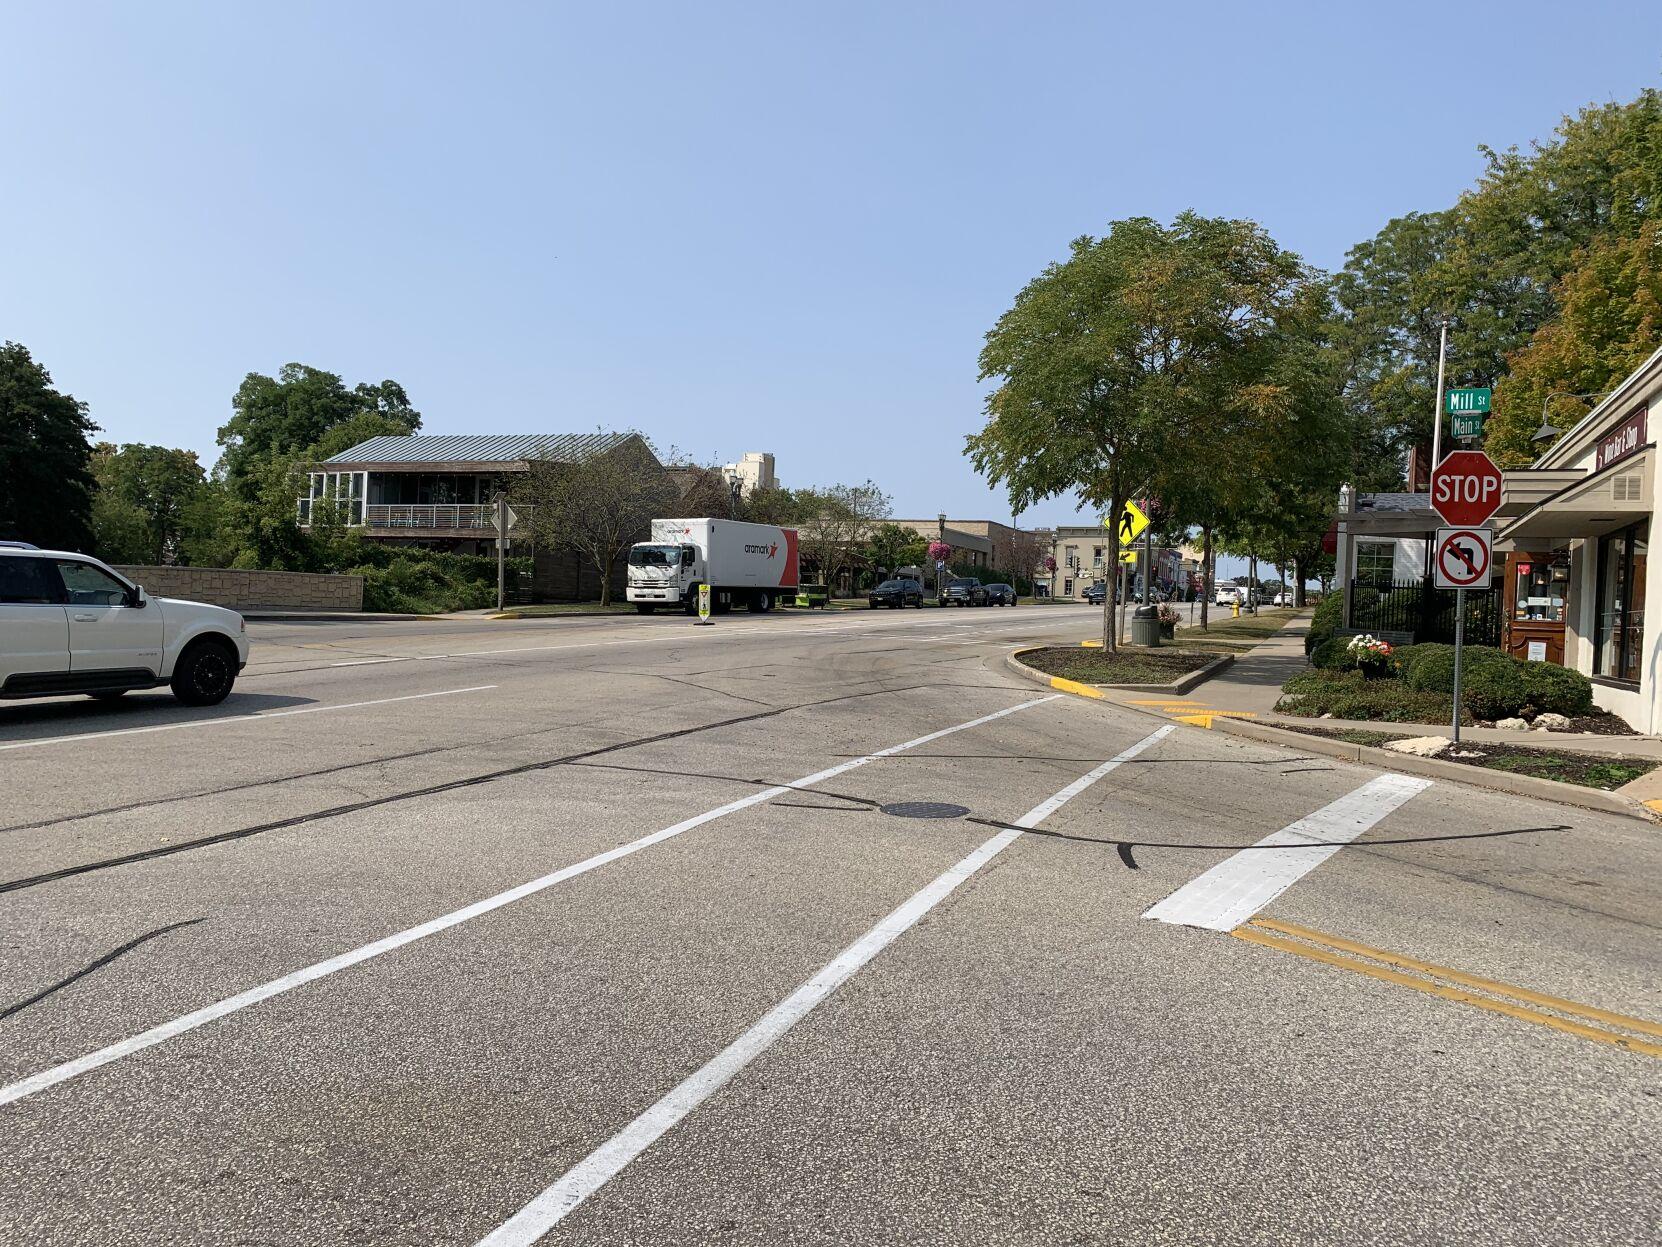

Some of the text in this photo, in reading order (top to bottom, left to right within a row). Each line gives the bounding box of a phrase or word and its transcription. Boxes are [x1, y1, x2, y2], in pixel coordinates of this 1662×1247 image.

[1450, 393, 1486, 410] Mill St
[1454, 417, 1473, 435] Main
[1435, 474, 1498, 503] STOP
[744, 543, 770, 555] aramark
